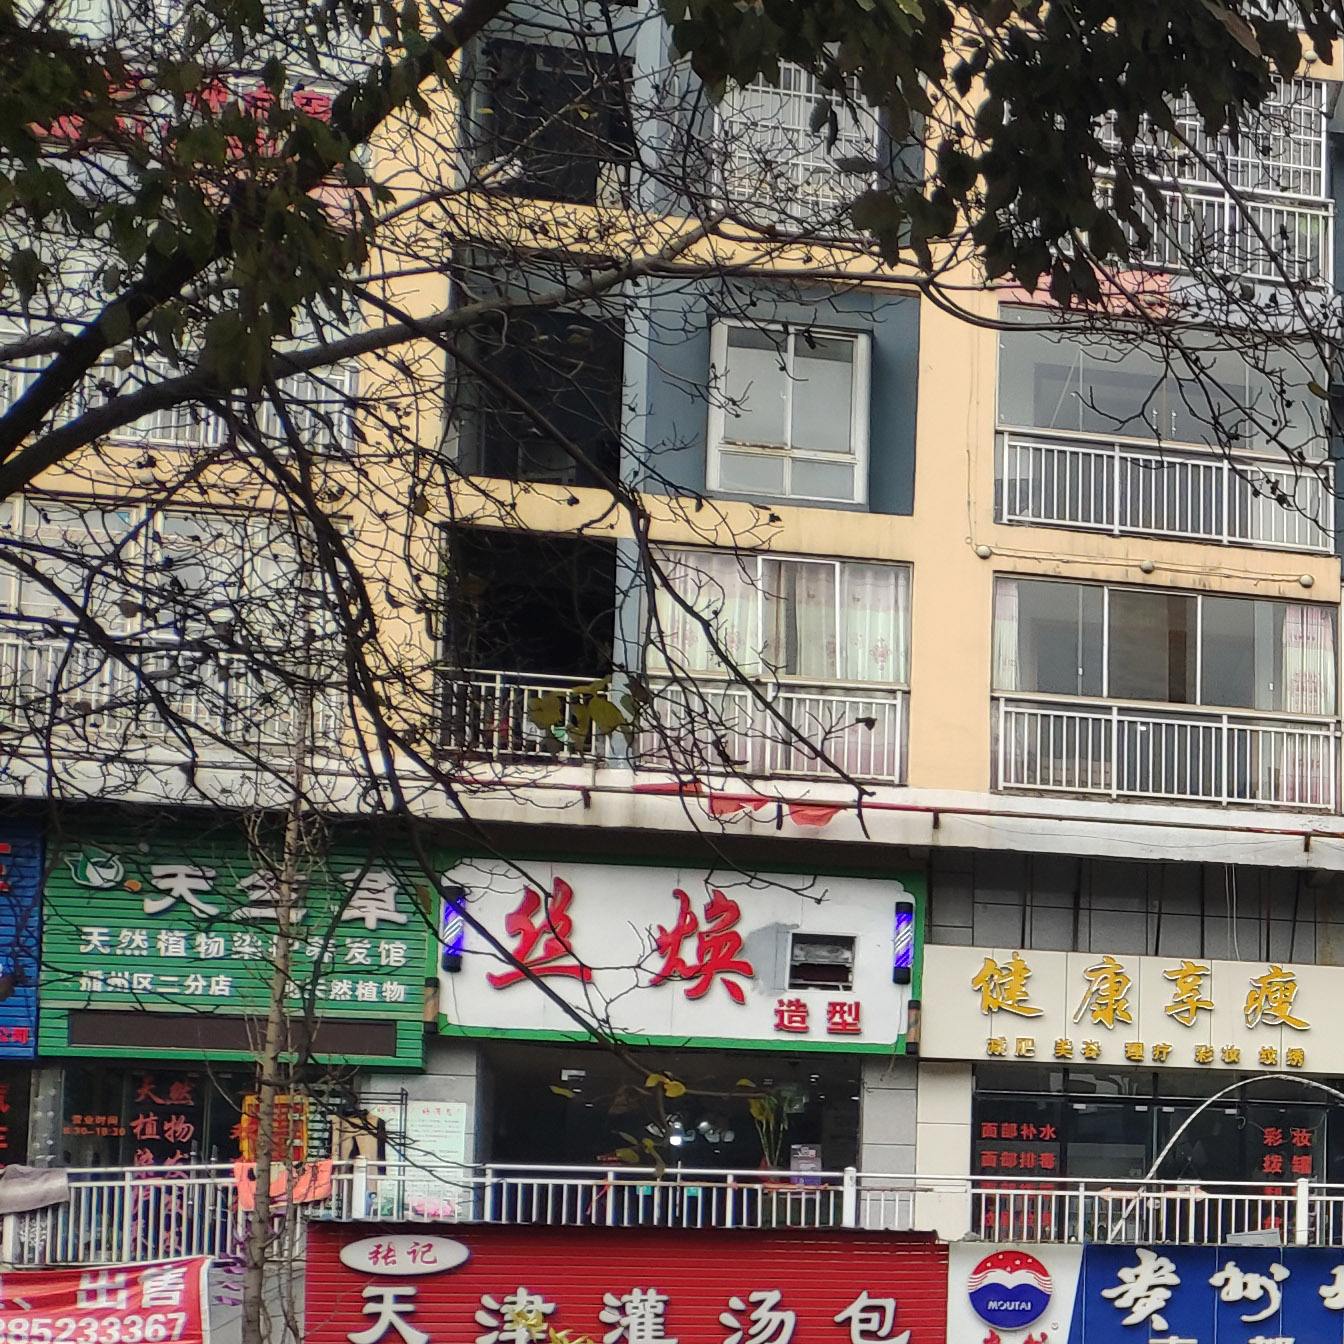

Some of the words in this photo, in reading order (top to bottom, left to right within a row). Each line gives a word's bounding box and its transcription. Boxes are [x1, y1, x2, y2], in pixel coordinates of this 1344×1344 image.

[970, 951, 1312, 1030] 健康享瘦
[774, 999, 862, 1034] 造型
[986, 1036, 1036, 1058] 减肥
[1055, 1038, 1102, 1060] 美容
[1124, 1040, 1172, 1063] 理疗
[1194, 1043, 1240, 1065] 彩妆
[1259, 1045, 1305, 1069] 纹绣
[131, 1113, 194, 1143] 植物
[980, 1123, 1057, 1140] 面部补水
[1263, 1127, 1312, 1146] 彩妆
[367, 1241, 438, 1266] 张记
[77, 1267, 188, 1309] 出售
[987, 1300, 1031, 1311] MOUTAI
